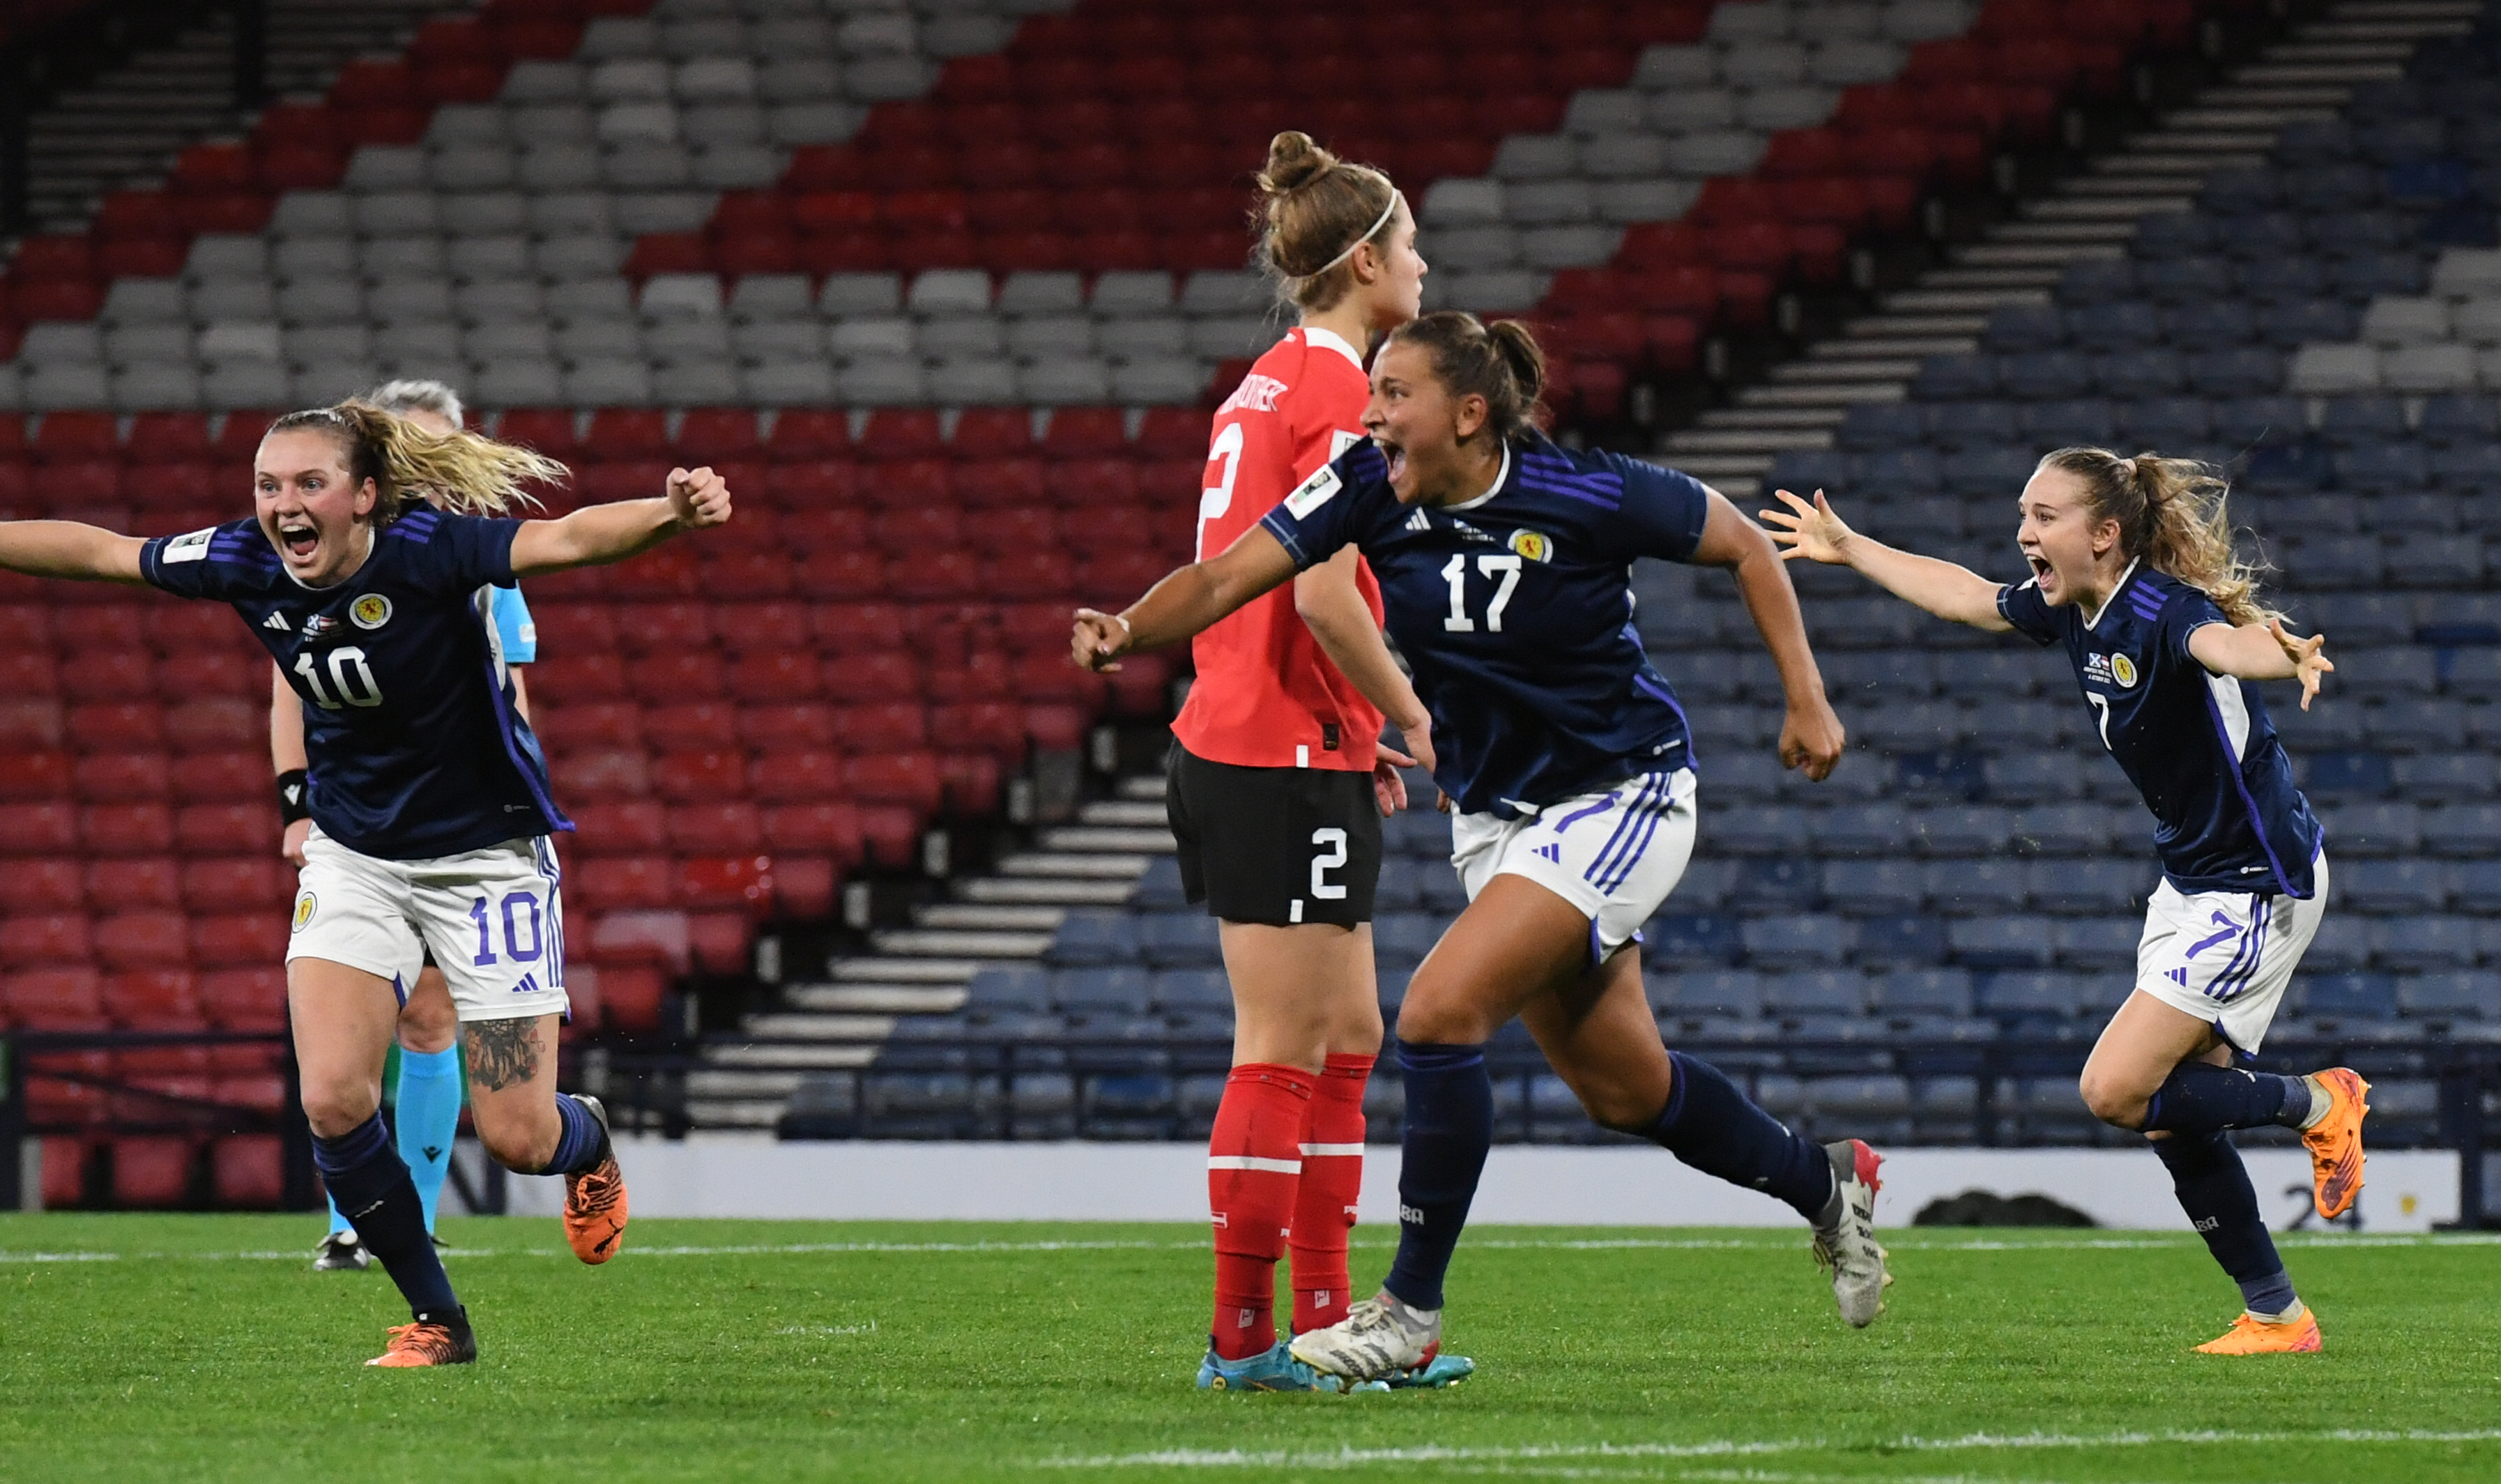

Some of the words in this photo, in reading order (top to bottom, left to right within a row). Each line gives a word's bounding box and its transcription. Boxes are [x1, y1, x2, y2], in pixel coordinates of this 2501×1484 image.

[1195, 422, 1244, 562] 2
[1440, 553, 1522, 633] 17
[293, 645, 384, 710] 10
[2086, 690, 2113, 751] 7
[1310, 827, 1347, 900] 2
[469, 891, 544, 967] 10
[2184, 910, 2246, 961] 7
[1400, 1204, 1425, 1226] BA
[2193, 1215, 2220, 1232] BA
